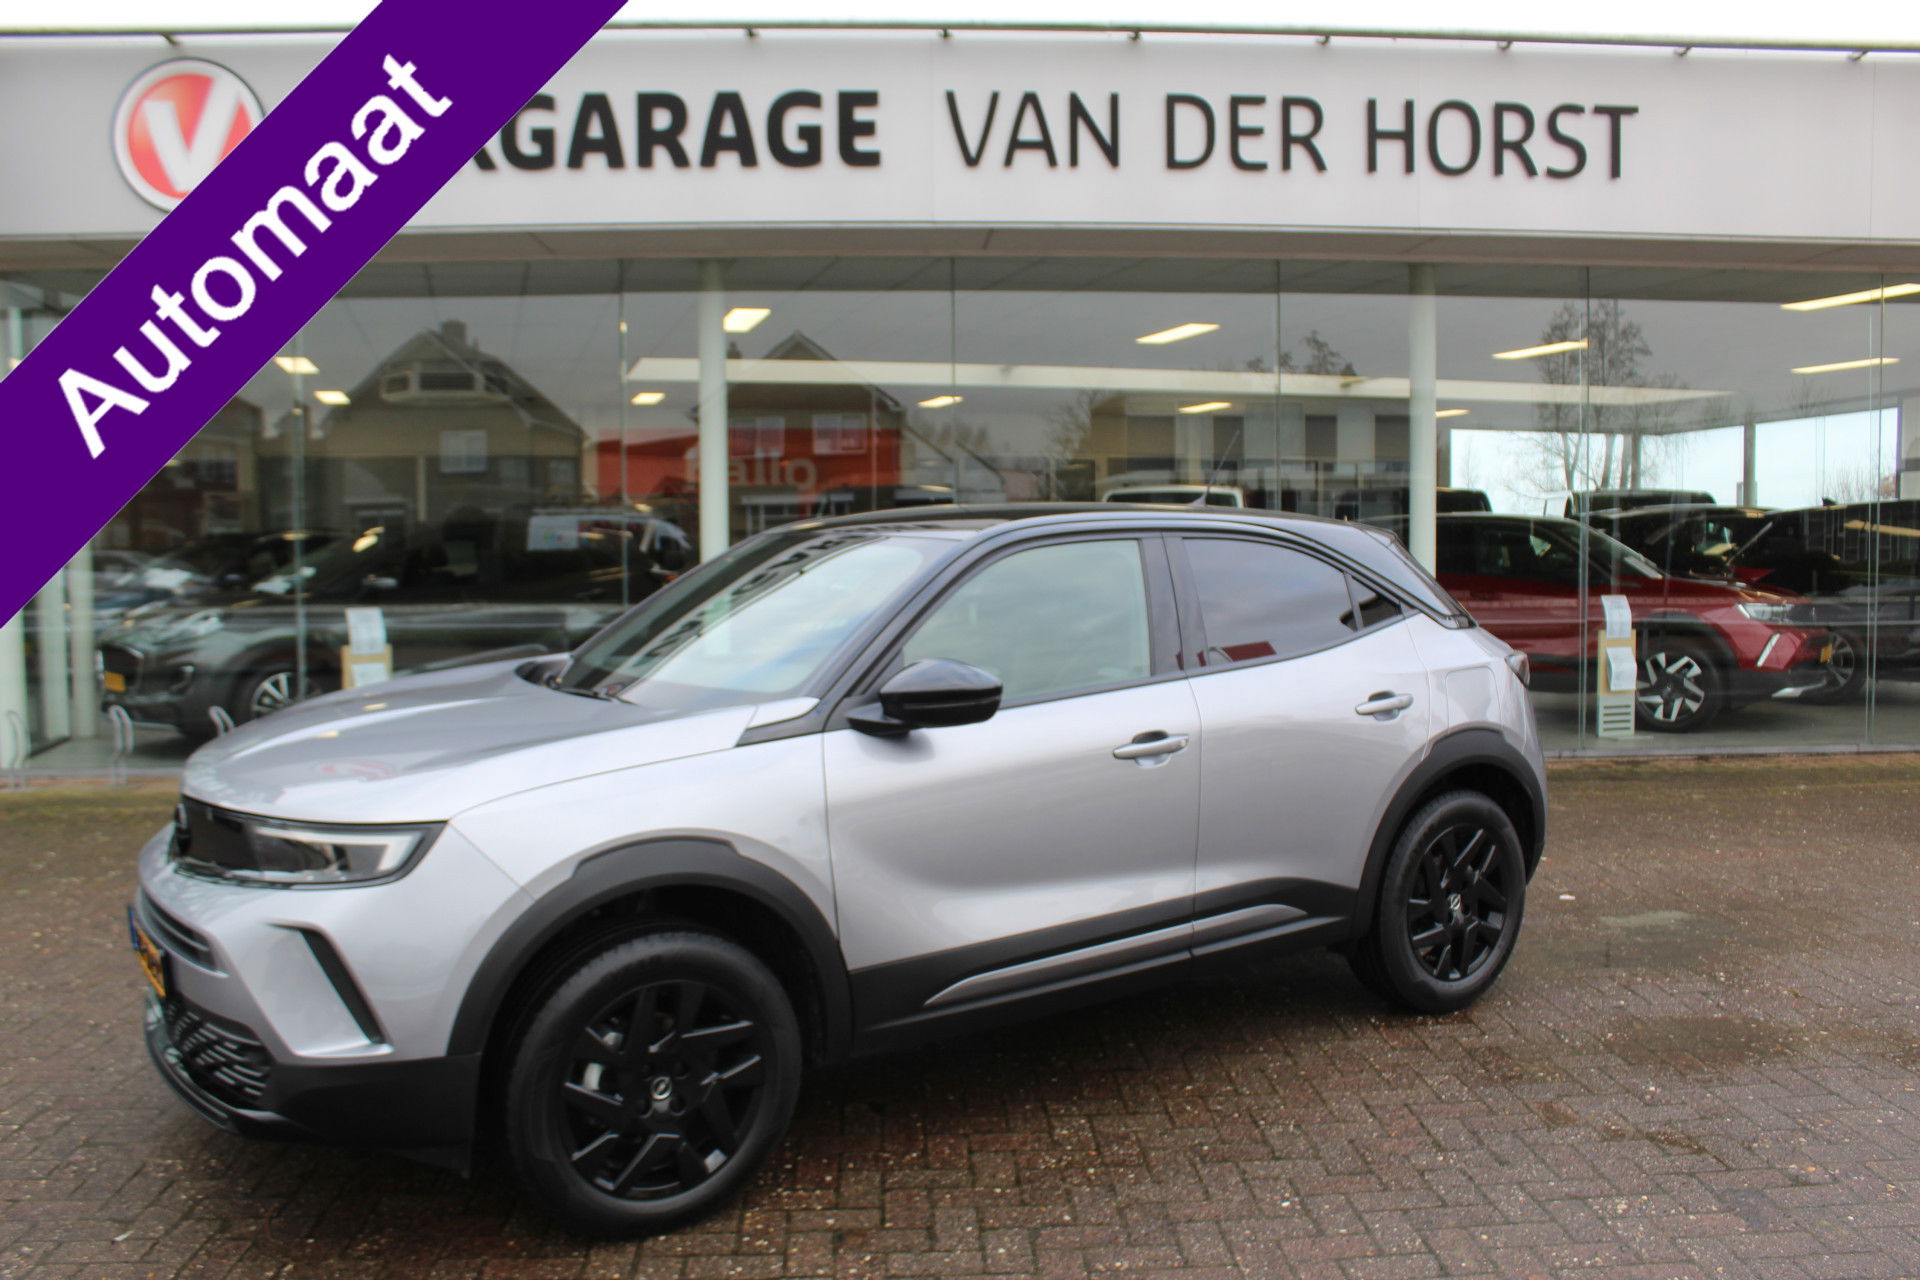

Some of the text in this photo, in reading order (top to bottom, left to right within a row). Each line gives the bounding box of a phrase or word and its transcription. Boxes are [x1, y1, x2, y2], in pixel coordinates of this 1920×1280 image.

[472, 91, 1639, 180] GARAGE VAN DER HORST
